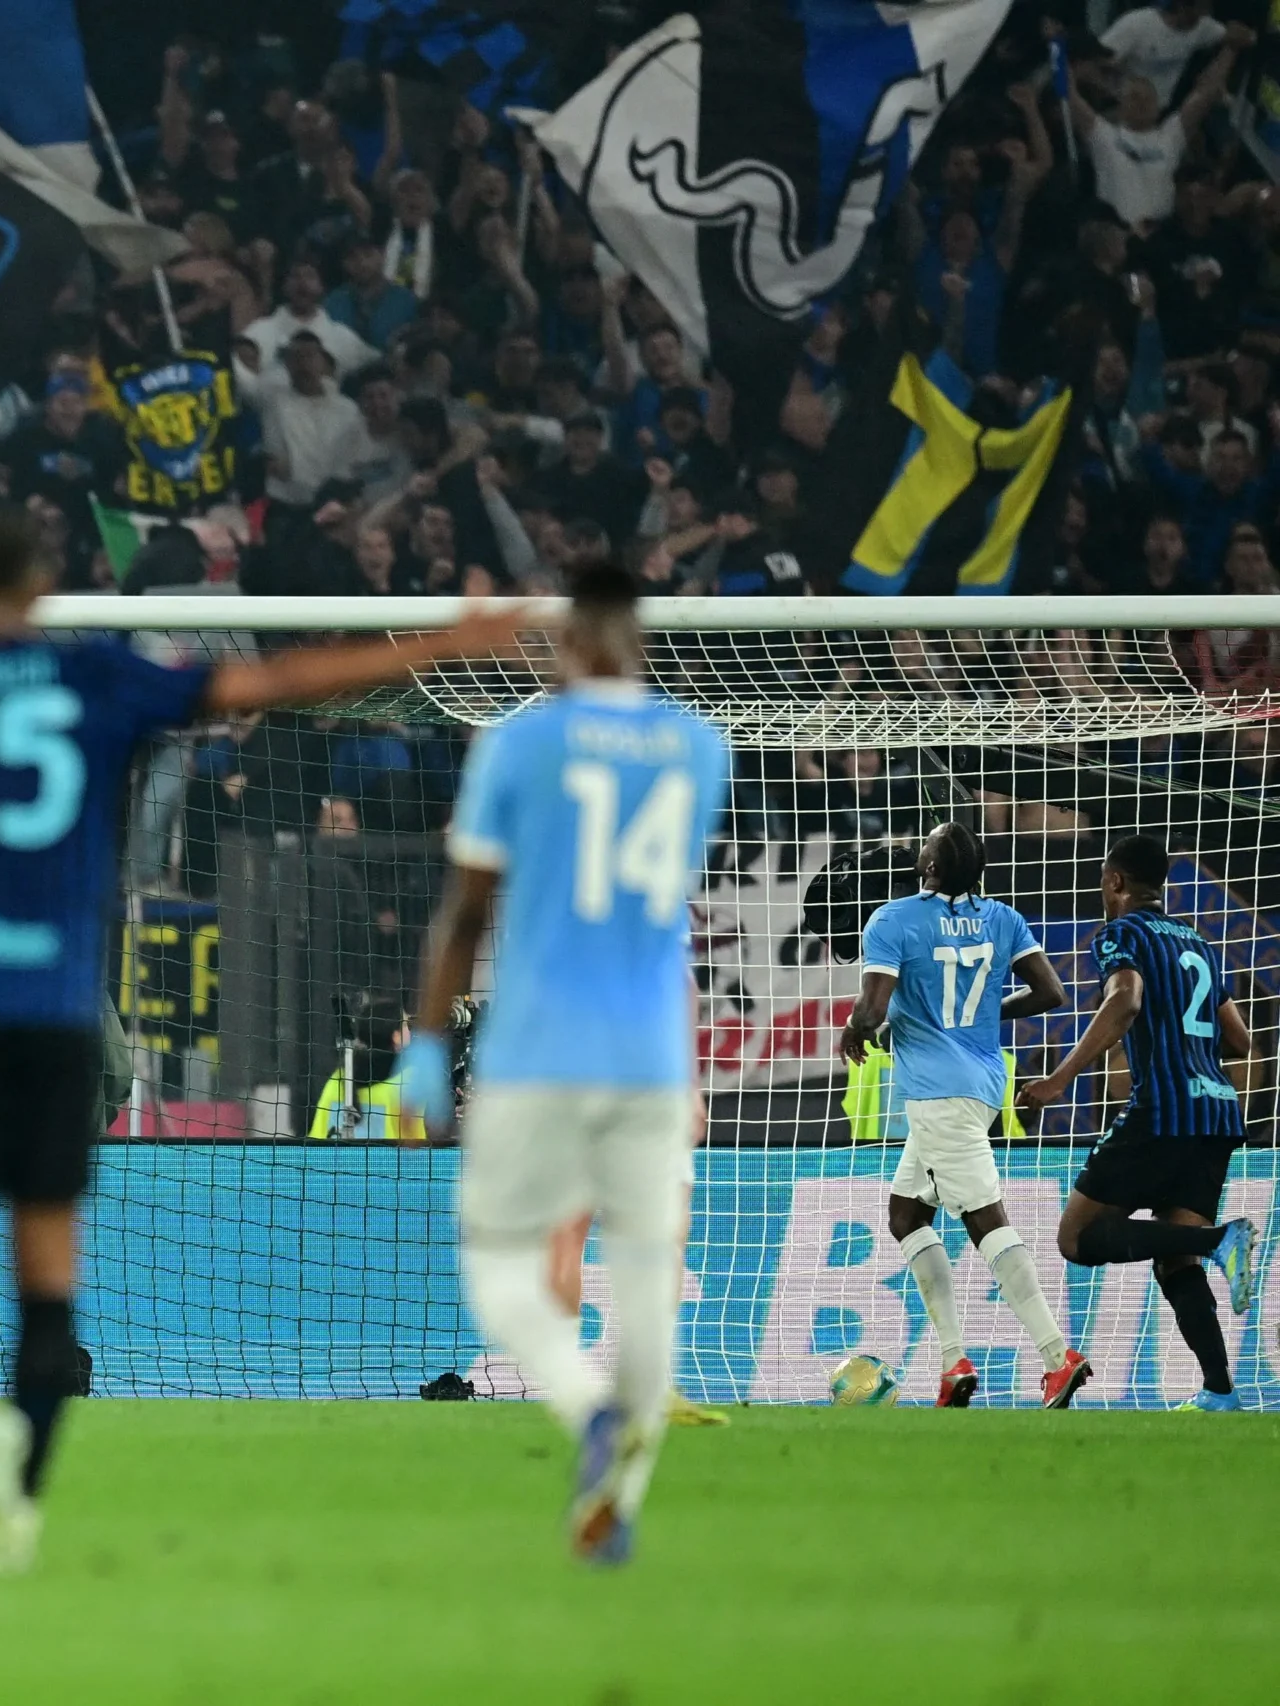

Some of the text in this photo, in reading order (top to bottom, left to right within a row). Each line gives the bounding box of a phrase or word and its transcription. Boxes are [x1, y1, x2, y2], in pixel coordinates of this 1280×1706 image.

[562, 760, 697, 928] 14
[932, 941, 994, 1030] 17
[1178, 950, 1214, 1039] 2
